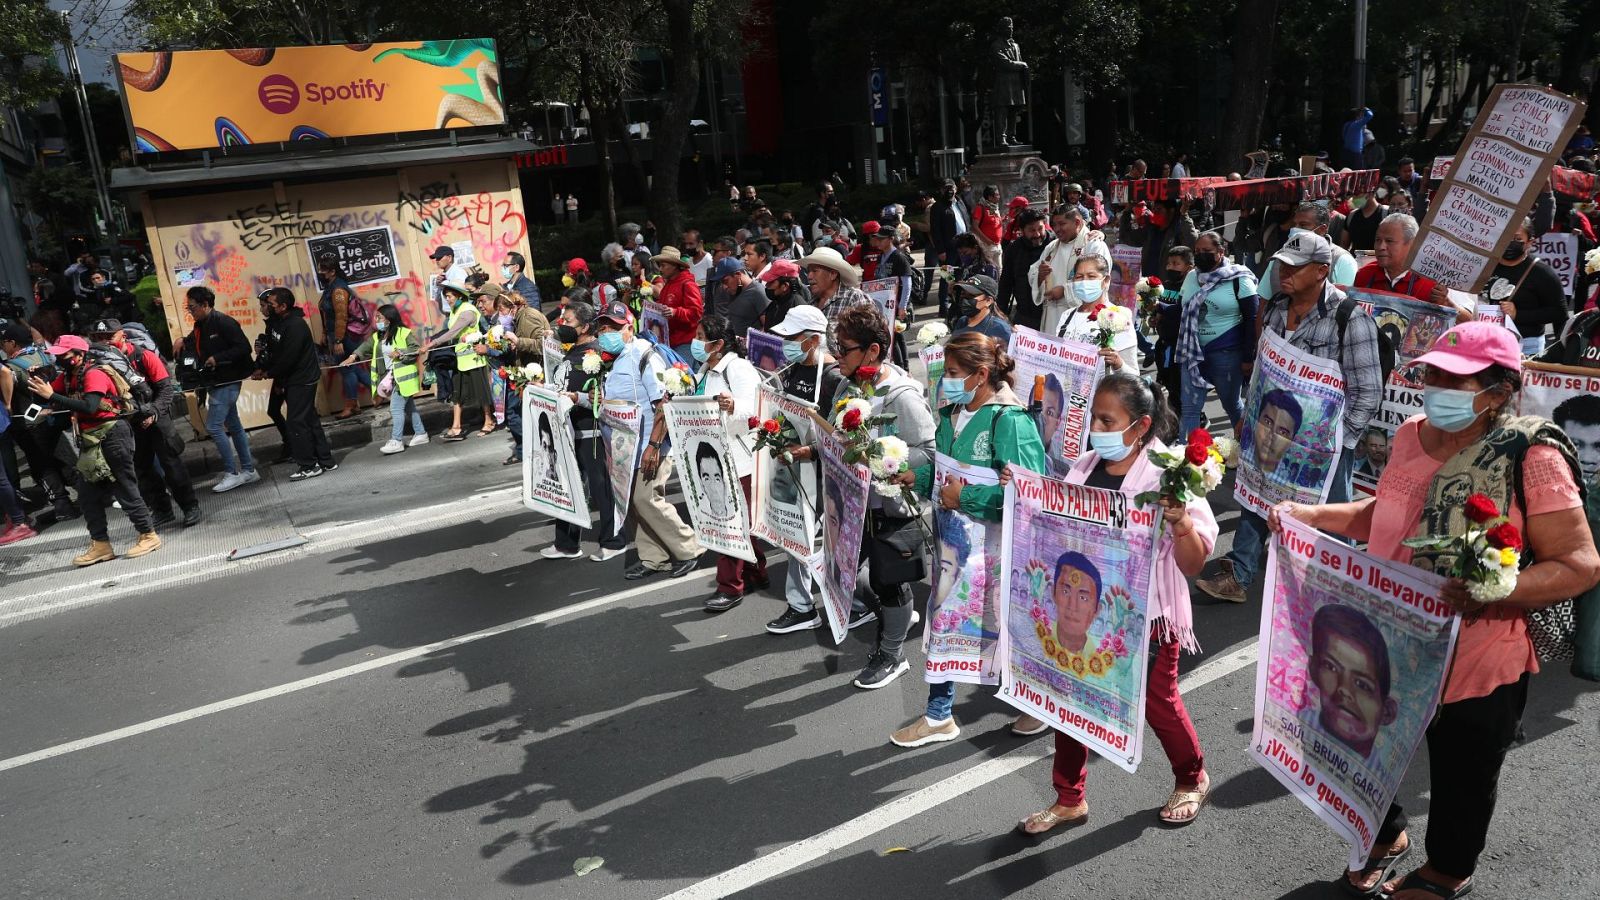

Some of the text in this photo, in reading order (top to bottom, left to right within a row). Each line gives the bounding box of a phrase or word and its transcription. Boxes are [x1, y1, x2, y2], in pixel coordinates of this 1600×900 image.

[305, 78, 385, 105] Spotify
[1504, 89, 1571, 115] 43 AYOTZINAPA
[1491, 113, 1549, 137] DE ESTADO
[1512, 102, 1552, 124] CRIMEN
[1474, 136, 1533, 168] 43 AYOTZINAPA
[1528, 137, 1553, 151] NIETO
[1470, 151, 1525, 178] CRIMINALES
[1470, 162, 1515, 189] EJERCITO
[1465, 174, 1500, 196] MARINA
[1451, 186, 1509, 219] 43 AYOTZINAPA
[1451, 199, 1497, 228] CRIMINALES
[1430, 232, 1442, 246] 43
[338, 246, 363, 260] Fue
[339, 251, 391, 277] Ejército
[1422, 244, 1474, 274] CRIMINALES
[1420, 257, 1469, 284] SENADORES
[884, 299, 895, 310] 43
[1015, 334, 1098, 367] ¡Vivo se lo llevaron!
[1287, 360, 1297, 374] lo
[1524, 373, 1600, 392] ¡Vivo se lo
[1065, 408, 1084, 440] FALTAN
[1063, 440, 1079, 460] NOS
[1042, 479, 1128, 529] NOS FALTAN 43!
[1239, 486, 1247, 498] lo
[1320, 549, 1342, 570] se
[1346, 556, 1364, 581] lo
[925, 659, 983, 672] eremos!
[1014, 680, 1043, 706] ¡Vivo
[1044, 695, 1056, 714] lo
[1058, 706, 1129, 752] queremos!
[1281, 716, 1306, 745] SAÚL
[1312, 739, 1349, 775] BRUNO
[1264, 737, 1300, 774] ¡Vivo
[1301, 765, 1315, 787] lo
[1317, 781, 1374, 850] queremos!
